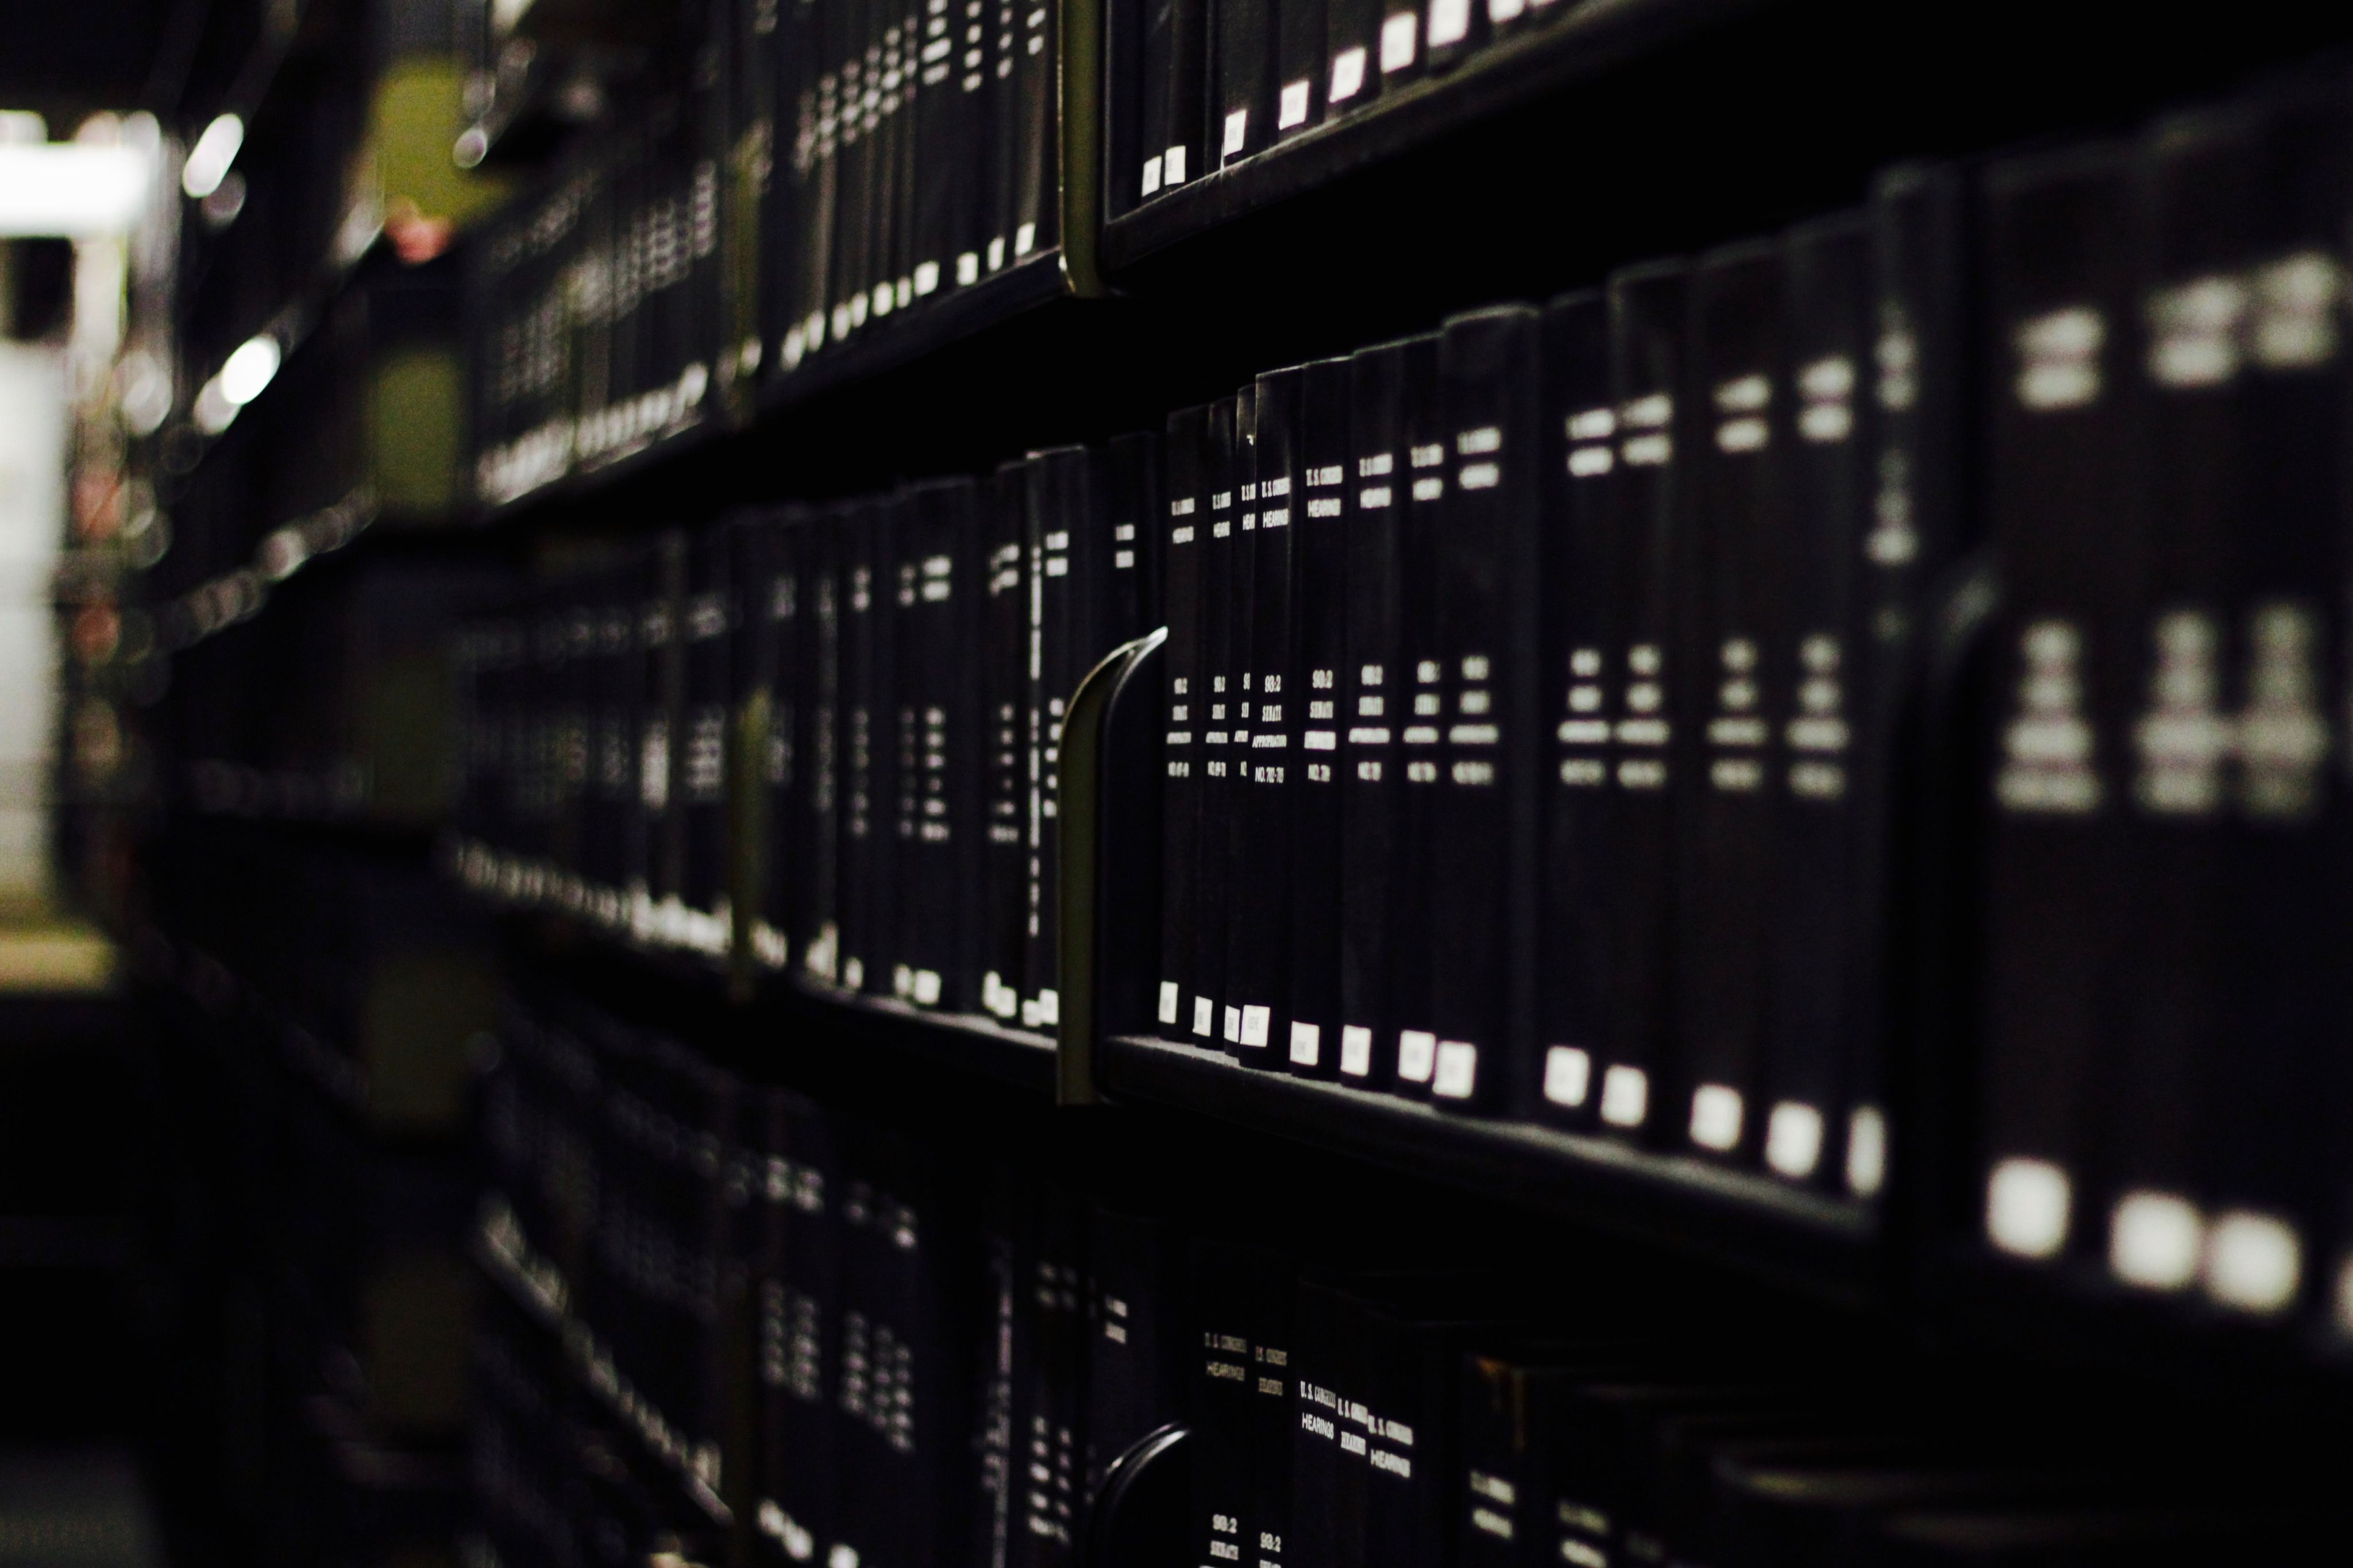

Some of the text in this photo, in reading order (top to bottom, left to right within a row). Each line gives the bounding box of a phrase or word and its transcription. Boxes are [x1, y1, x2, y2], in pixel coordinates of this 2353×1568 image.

[1301, 1381, 1306, 1397] U.
[1308, 1384, 1313, 1400] S.
[1302, 1413, 1334, 1439] HEARINGS
